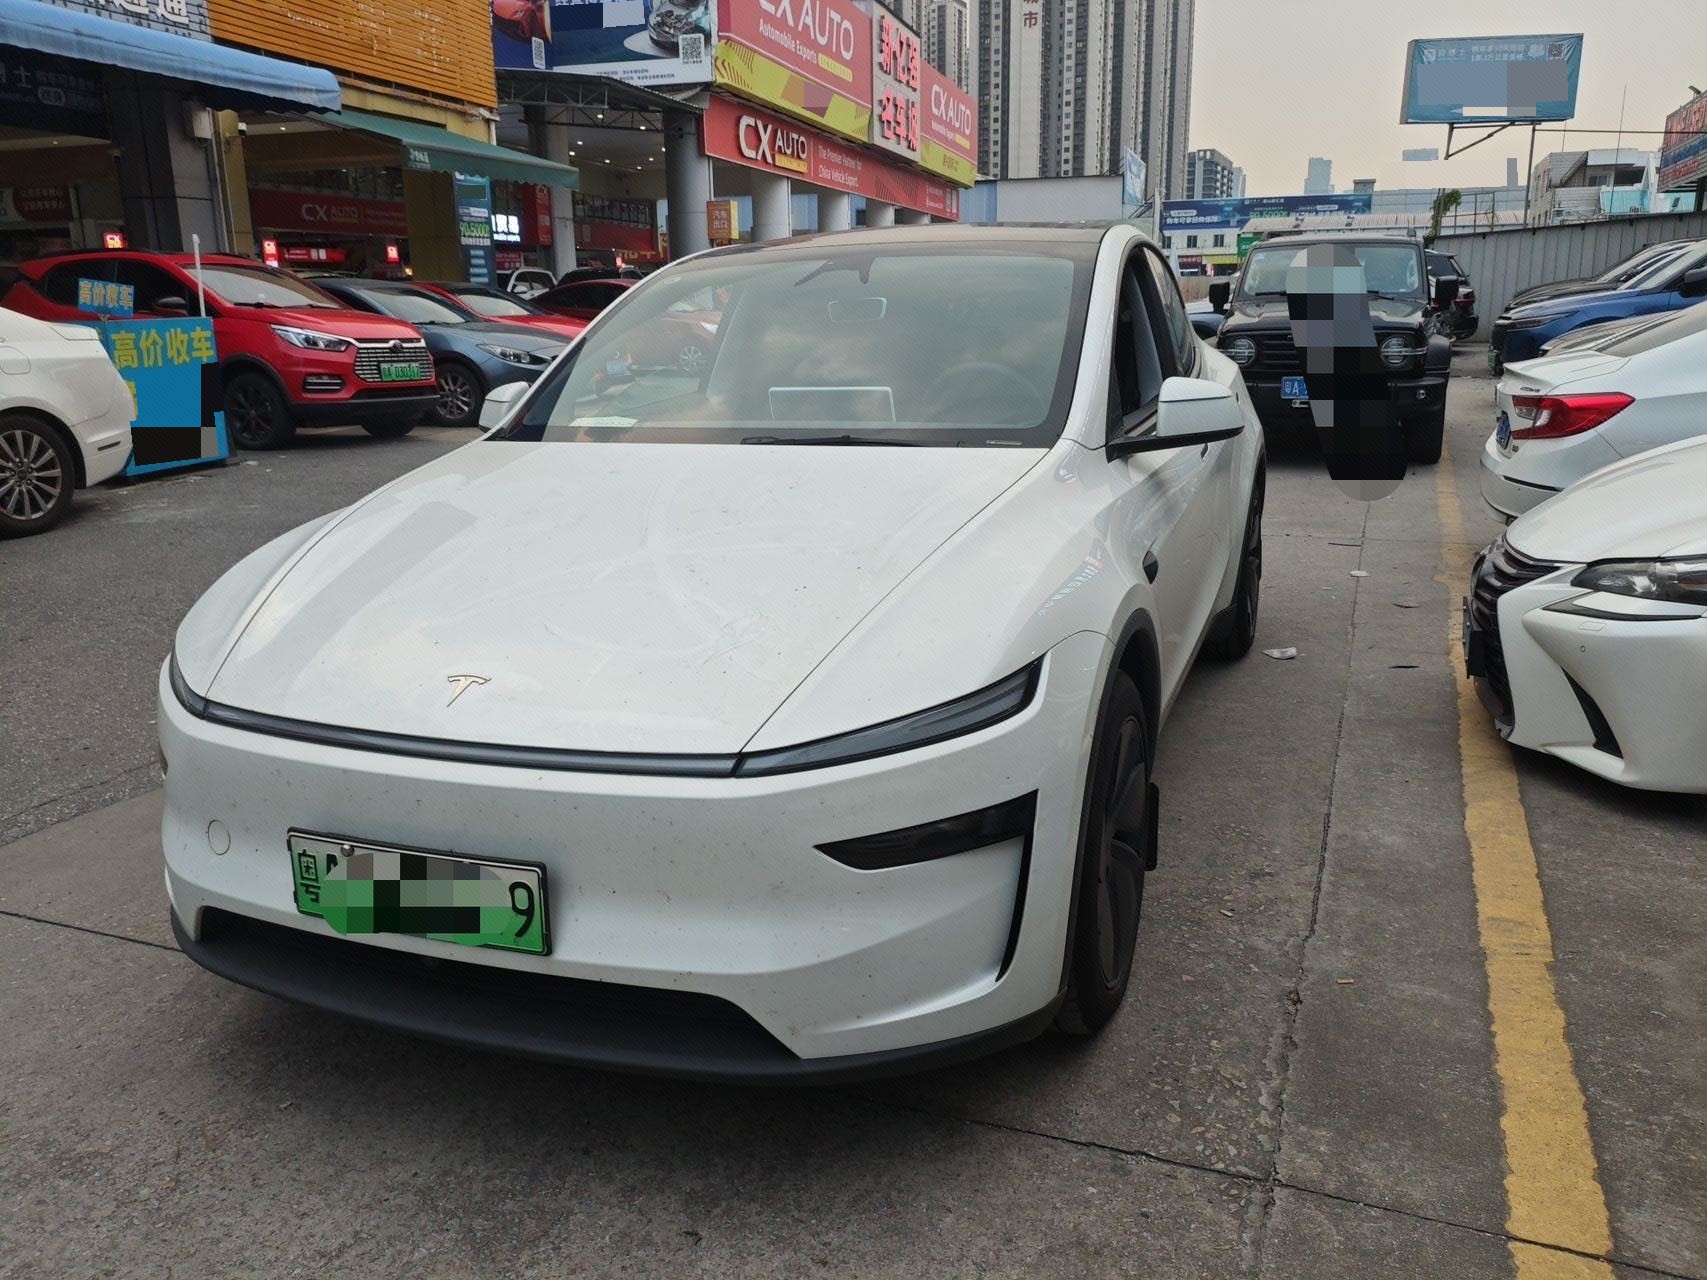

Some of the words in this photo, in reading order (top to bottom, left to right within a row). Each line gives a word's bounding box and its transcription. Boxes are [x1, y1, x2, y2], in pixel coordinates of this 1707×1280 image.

[759, 0, 795, 27] X
[798, 0, 854, 60] AUTO
[759, 18, 795, 52] Automobile
[796, 40, 817, 64] Exports
[931, 84, 947, 120] CX
[947, 97, 972, 136] AUTO
[739, 114, 773, 164] CX
[775, 128, 807, 160] AUTO
[818, 145, 827, 158] The
[827, 147, 842, 164] Premier
[842, 153, 857, 168] Partner
[819, 164, 831, 179] China
[831, 167, 845, 183] Vehicle
[302, 204, 328, 222] CX
[79, 281, 134, 309] 高价收车
[111, 326, 215, 369] 高价收车
